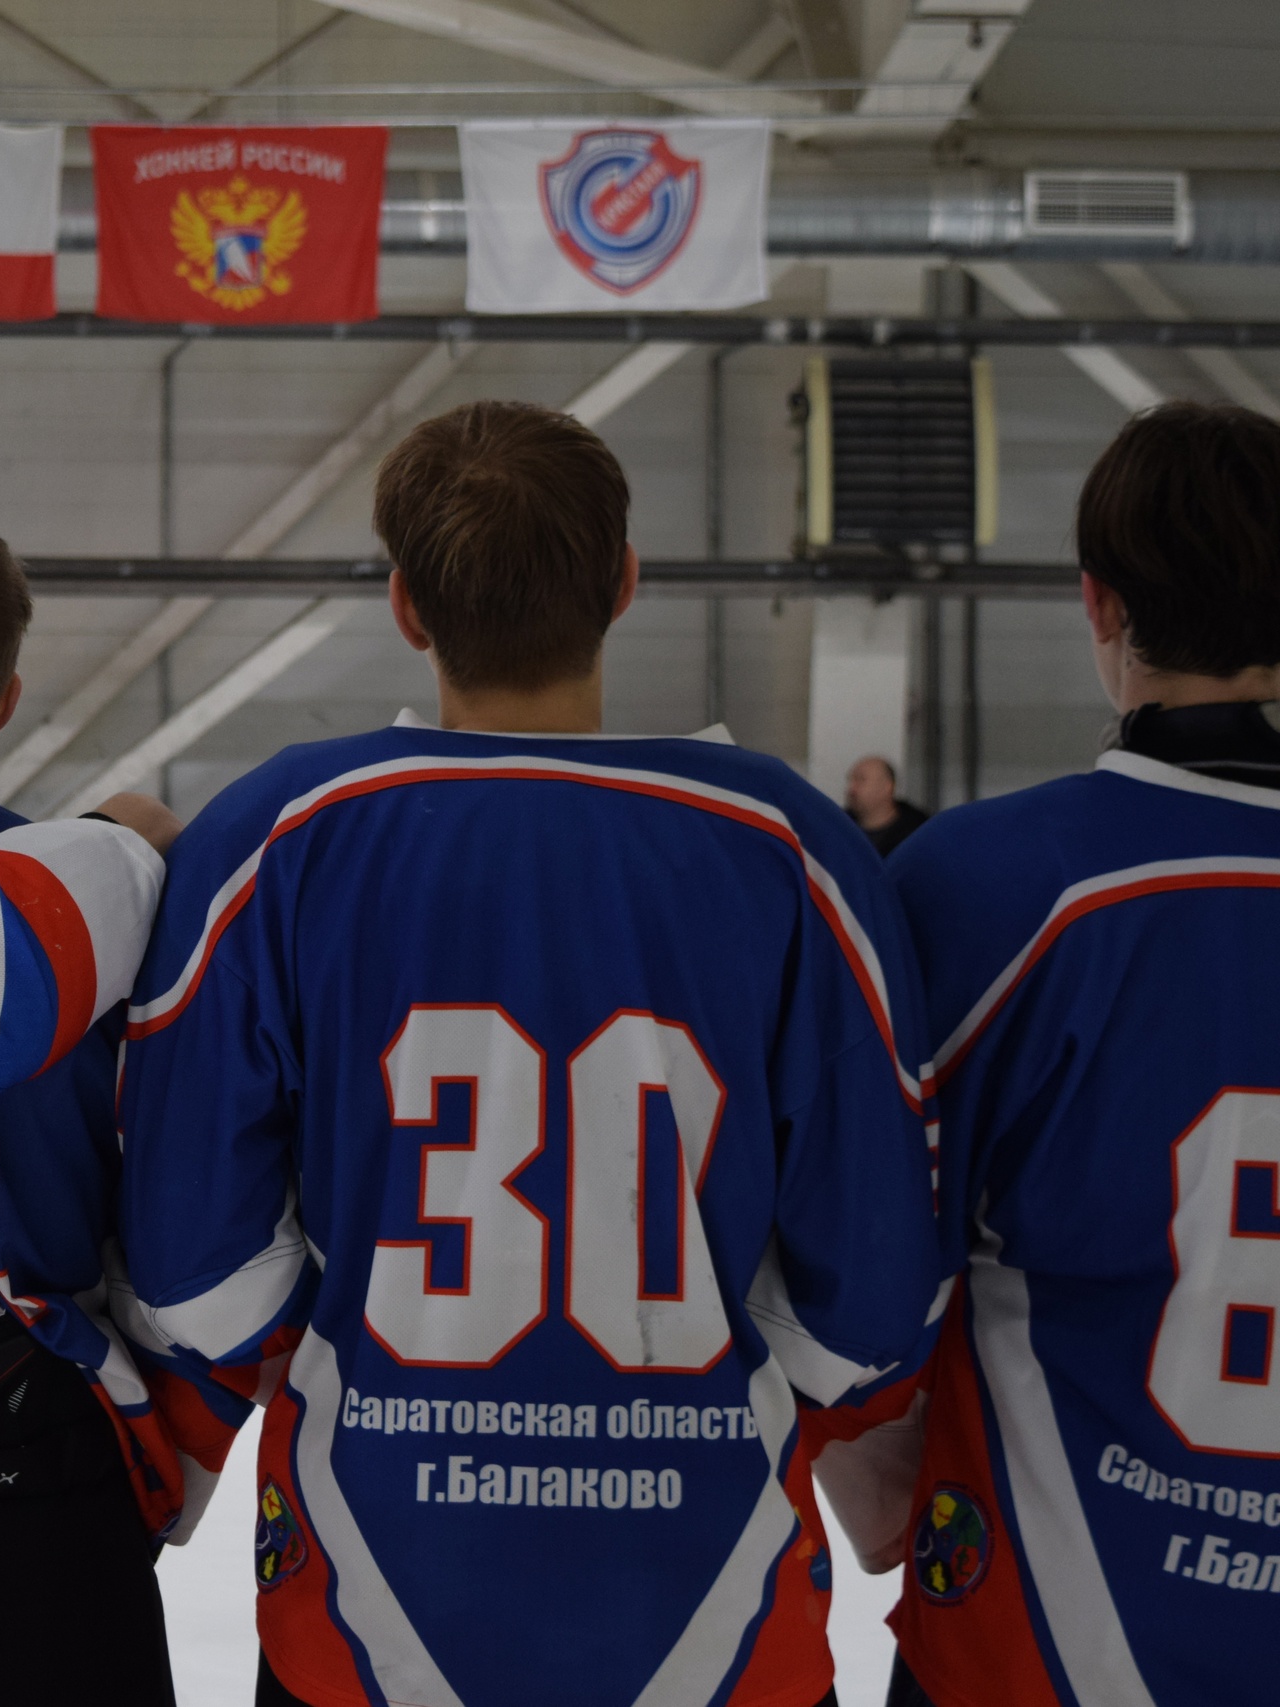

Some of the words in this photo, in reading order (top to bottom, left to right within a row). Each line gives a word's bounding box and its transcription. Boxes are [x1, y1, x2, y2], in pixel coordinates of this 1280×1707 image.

[241, 142, 347, 184] РОССИИ
[362, 1002, 734, 1375] 30
[342, 1387, 598, 1439] Саратовская
[607, 1399, 760, 1441] область
[416, 1455, 683, 1509] г.Балаково
